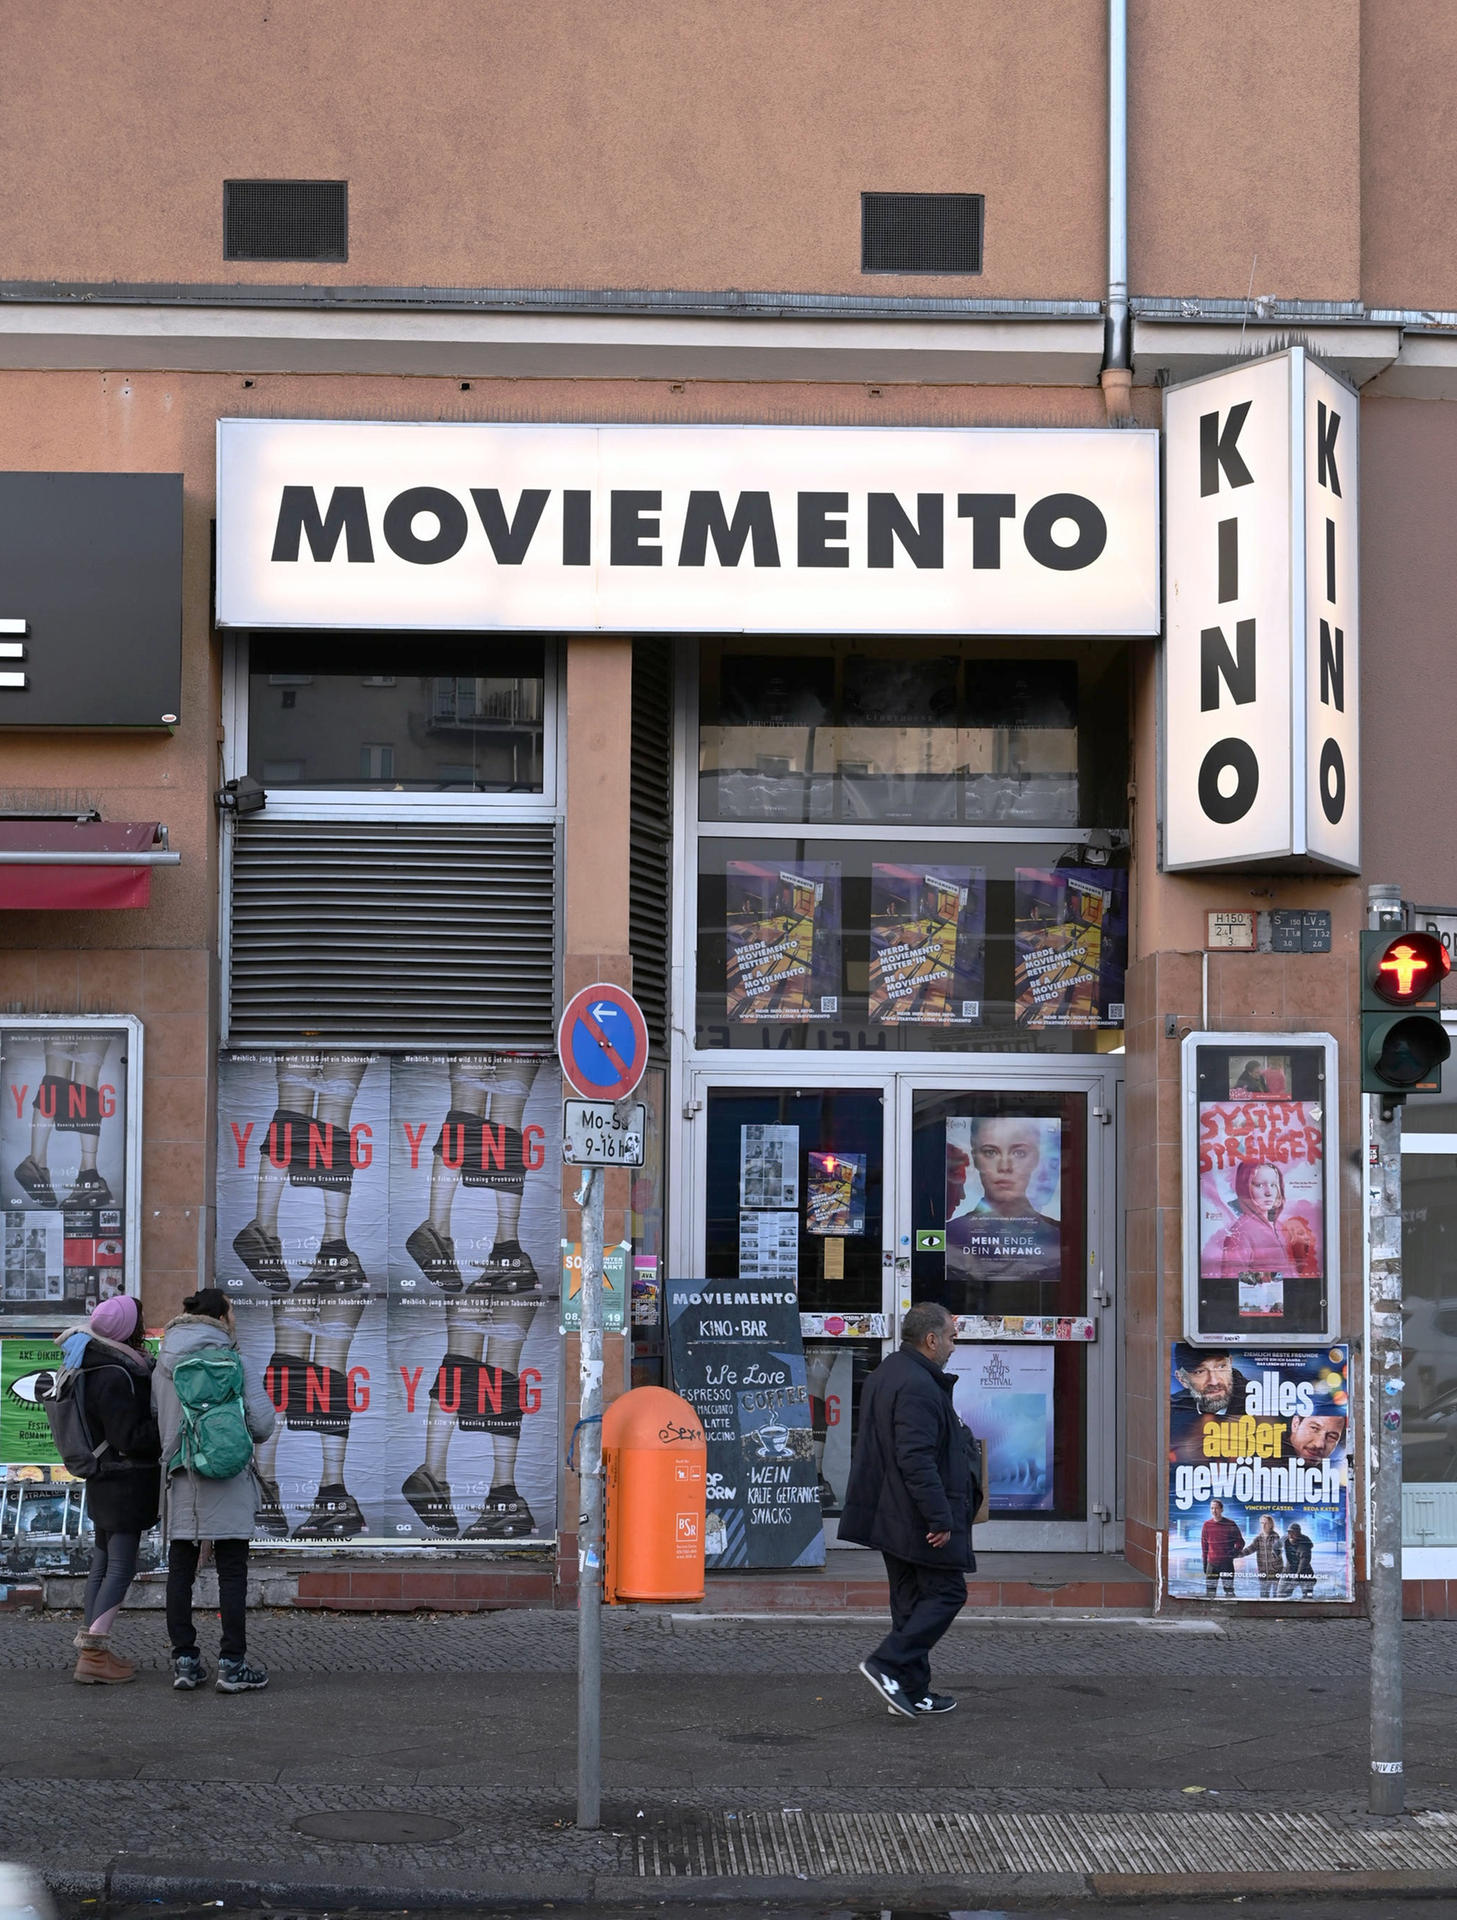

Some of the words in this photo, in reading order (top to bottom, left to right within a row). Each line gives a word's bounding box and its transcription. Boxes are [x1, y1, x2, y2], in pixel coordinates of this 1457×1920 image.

[271, 485, 1108, 571] MOVIEMENTO
[1198, 400, 1259, 824] KINO
[1317, 400, 1346, 825] KINO
[1274, 915, 1281, 925] S
[1304, 917, 1316, 926] LV
[734, 941, 767, 955] WERDE
[737, 941, 798, 962] MOVIEMENTO
[877, 943, 910, 956] WERDE
[880, 944, 941, 965] MOVIEMENTO
[1023, 947, 1054, 961] WERDE
[1025, 947, 1086, 970] MOVIEMENTO
[742, 973, 753, 981] BE
[756, 970, 763, 978] A
[744, 967, 805, 989] MOVIEMENTO
[884, 975, 896, 984] BE
[887, 971, 948, 991] MOVIEMENTO
[1030, 979, 1041, 988] BE
[1044, 976, 1051, 984] A
[746, 984, 771, 997] HERO
[888, 987, 913, 999] HERO
[1032, 974, 1093, 995] MOVIEMENTO
[1034, 991, 1059, 1004] HERO
[301, 1055, 319, 1063] YUNG
[11, 1084, 116, 1118] YUNG
[1200, 1101, 1306, 1140] SYSTEM
[230, 1122, 373, 1169] YUNG
[403, 1123, 545, 1171] YUNG
[585, 1137, 615, 1157] 9-16
[1199, 1126, 1322, 1174] SPRENGER
[971, 1236, 1000, 1245] MEIN
[962, 1246, 990, 1255] DEIN
[993, 1247, 1045, 1255] ANFANG.
[673, 1292, 797, 1305] MOVIEMENTO
[19, 1350, 35, 1360] AKE
[705, 1364, 737, 1384] We
[743, 1364, 785, 1384] Love
[980, 1378, 1012, 1386] FESTIVAL
[266, 1366, 370, 1413] UNG
[400, 1366, 542, 1414] YUNG
[680, 1388, 731, 1401] ESPRESSO
[1245, 1371, 1314, 1417] alles
[742, 1385, 808, 1412] COFFEE
[704, 1418, 731, 1429] LATTE
[705, 1431, 735, 1441] UCCINO
[1202, 1415, 1287, 1459] außer
[1175, 1456, 1340, 1510] gewöhnlich
[10, 1490, 50, 1500] CNTRAL
[706, 1487, 737, 1500] ORN
[747, 1487, 772, 1504] KALTE
[751, 1508, 792, 1524] SNACKS
[679, 1518, 696, 1536] BSR
